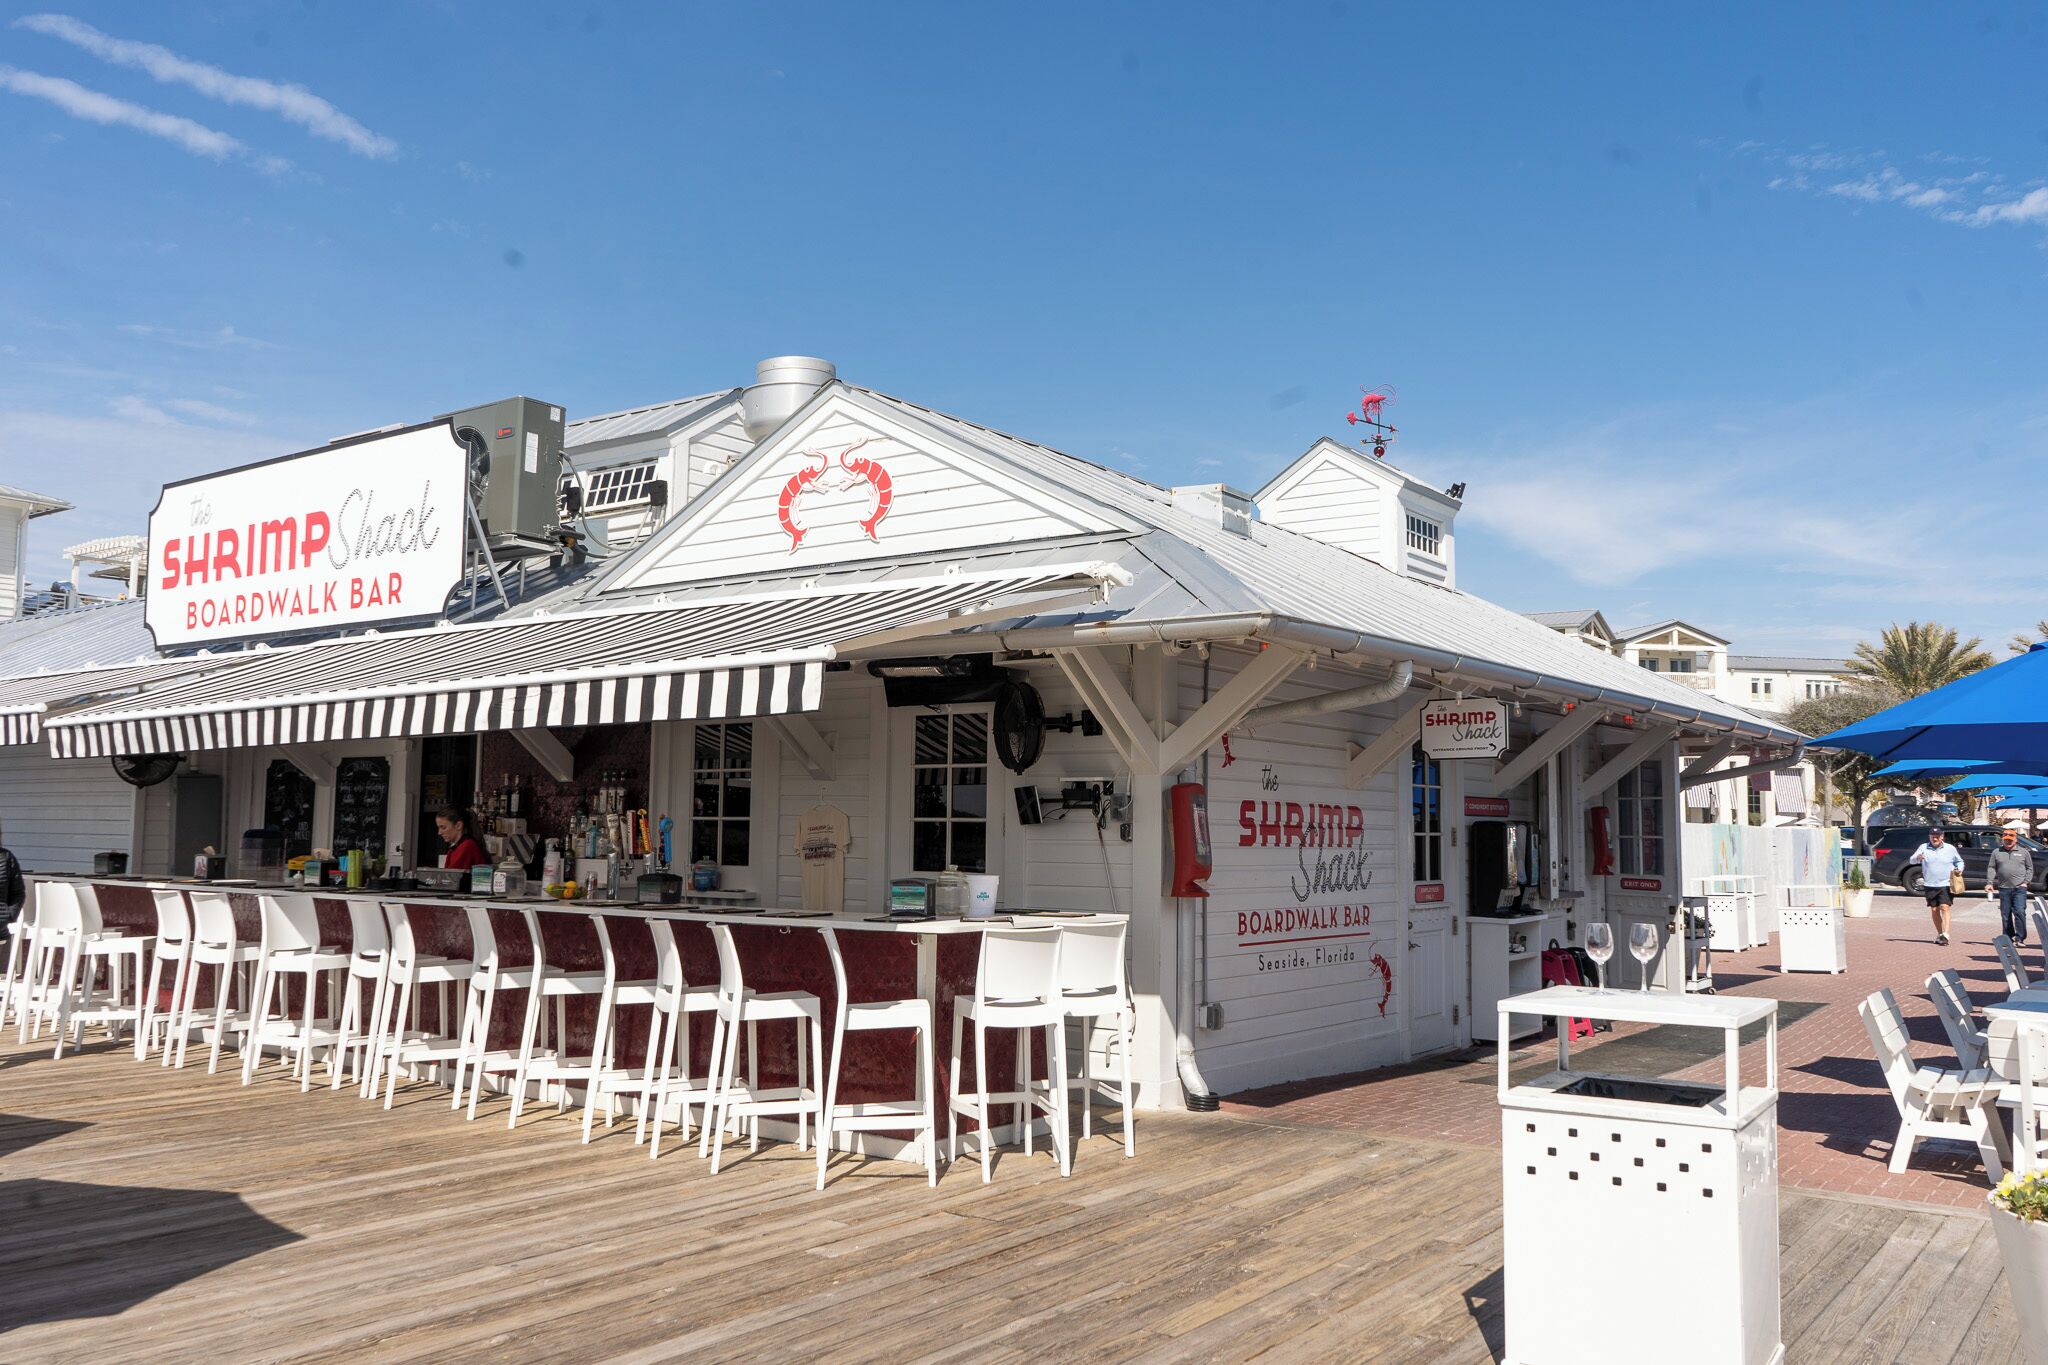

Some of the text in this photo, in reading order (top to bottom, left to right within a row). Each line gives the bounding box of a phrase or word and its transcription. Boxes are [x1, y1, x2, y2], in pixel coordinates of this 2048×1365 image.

[162, 479, 440, 590] SHRIMP Shack
[187, 572, 402, 630] BOARDWALK BAR
[1426, 711, 1496, 726] SHRIMP
[1452, 720, 1502, 742] Shack
[1261, 764, 1280, 792] the
[1238, 800, 1365, 848] SHRIMP
[1291, 824, 1373, 902] Shack
[1237, 905, 1370, 936] BOARDWALK BAR
[1258, 946, 1355, 972] Seaside, Florida
